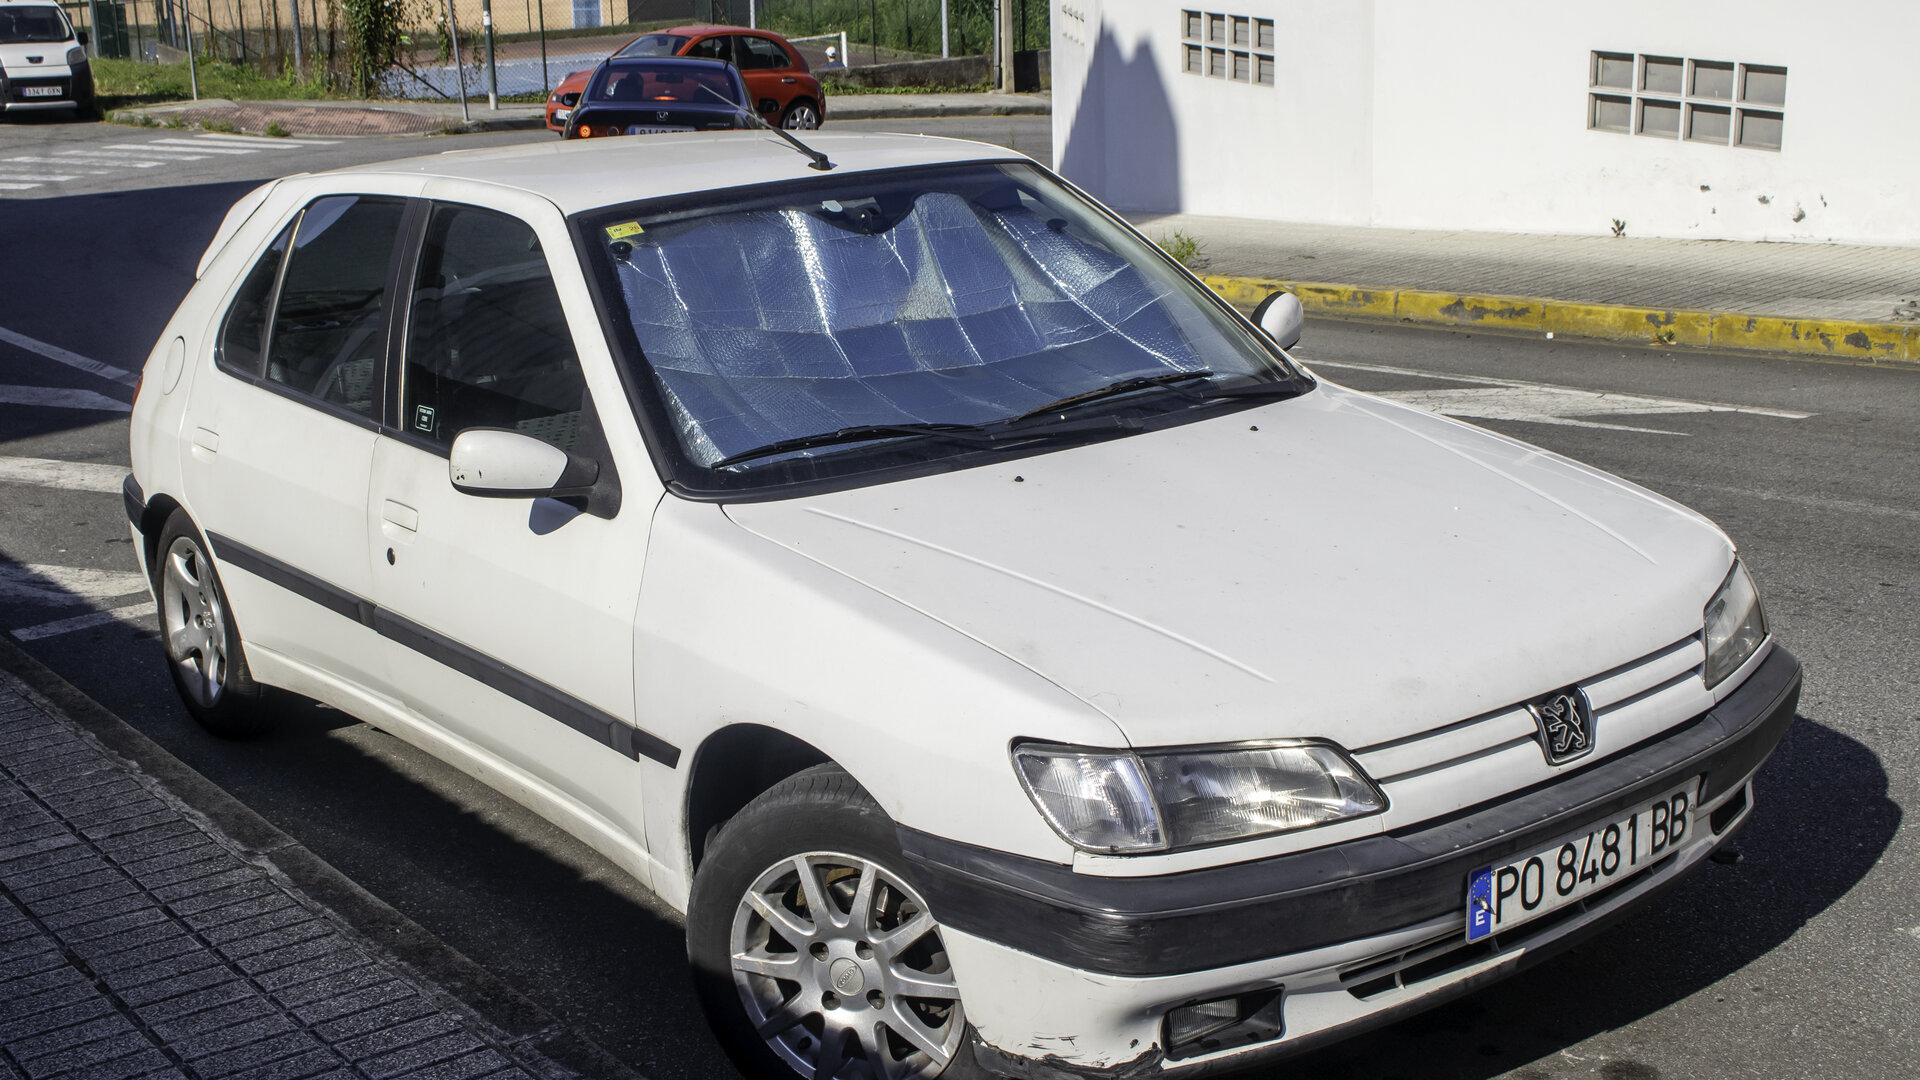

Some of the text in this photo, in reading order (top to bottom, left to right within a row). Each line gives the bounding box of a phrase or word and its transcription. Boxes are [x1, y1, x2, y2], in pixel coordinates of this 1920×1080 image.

[1496, 791, 1689, 924] PO 8481 BB
[1475, 909, 1486, 926] E
